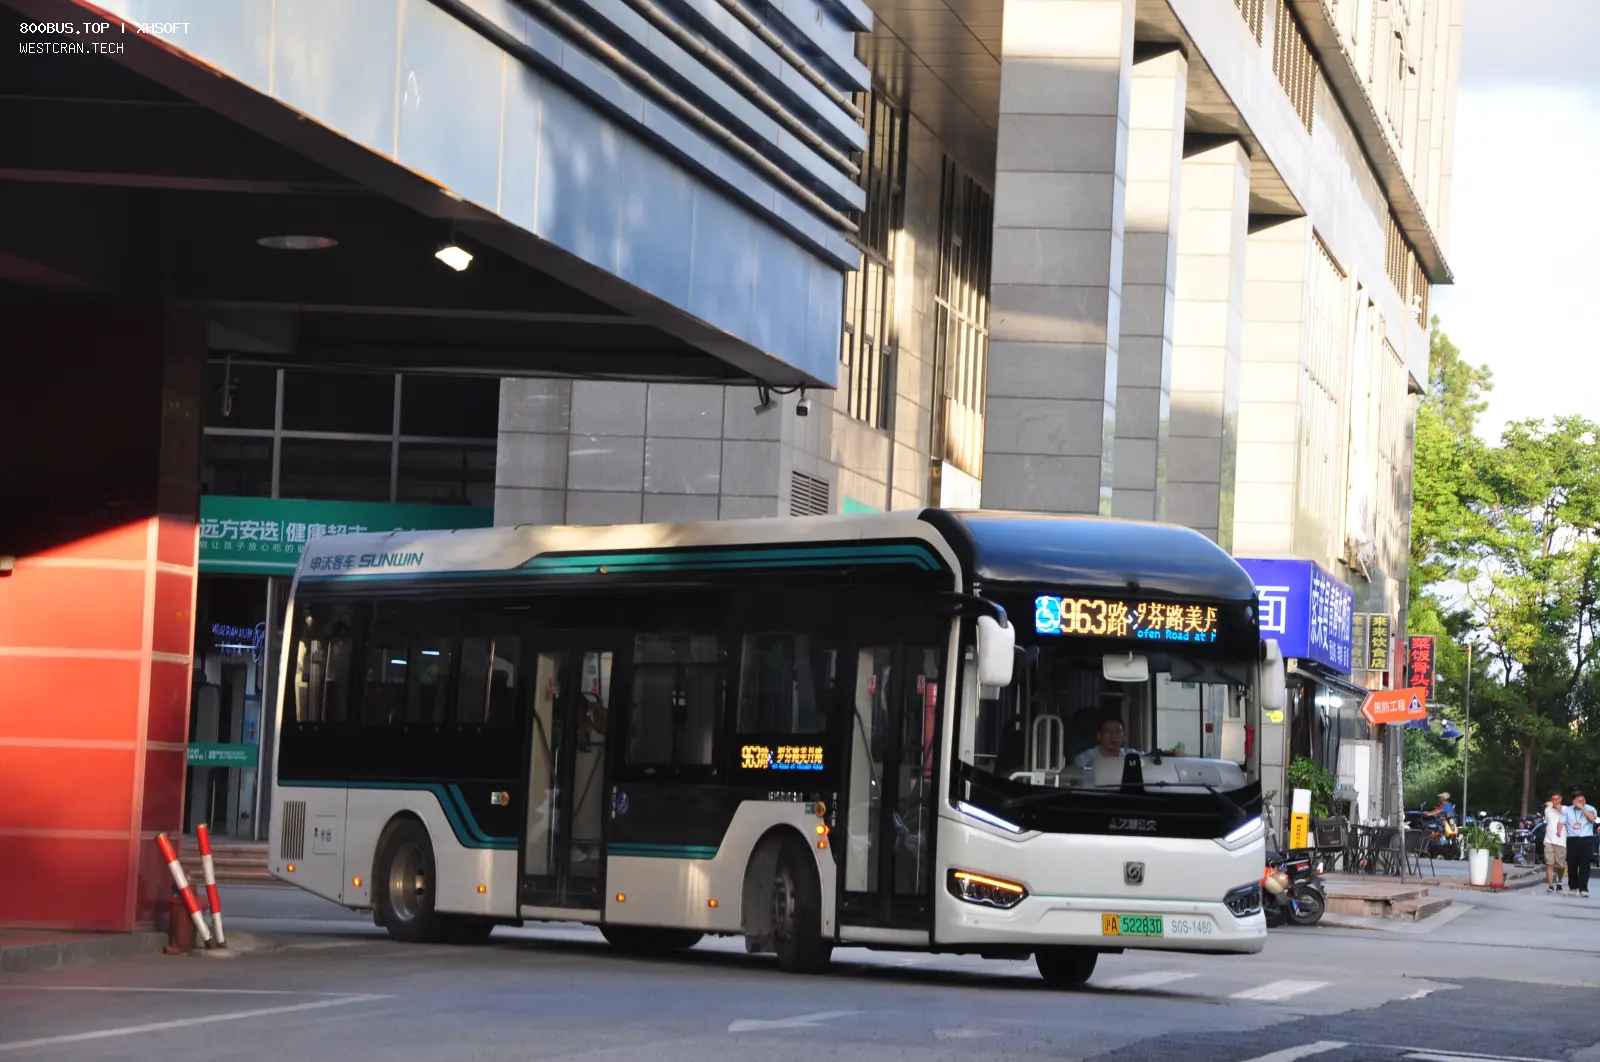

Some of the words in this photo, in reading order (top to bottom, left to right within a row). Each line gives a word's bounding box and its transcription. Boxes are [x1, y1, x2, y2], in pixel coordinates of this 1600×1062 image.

[358, 552, 424, 568] SUNWIN
[1060, 598, 1128, 636] 963路
[1165, 629, 1190, 640] Road
[1194, 631, 1206, 642] at
[1410, 637, 1432, 696] 菜饭骨头
[1374, 699, 1406, 714] 民防工程
[1122, 918, 1163, 933] 52283D
